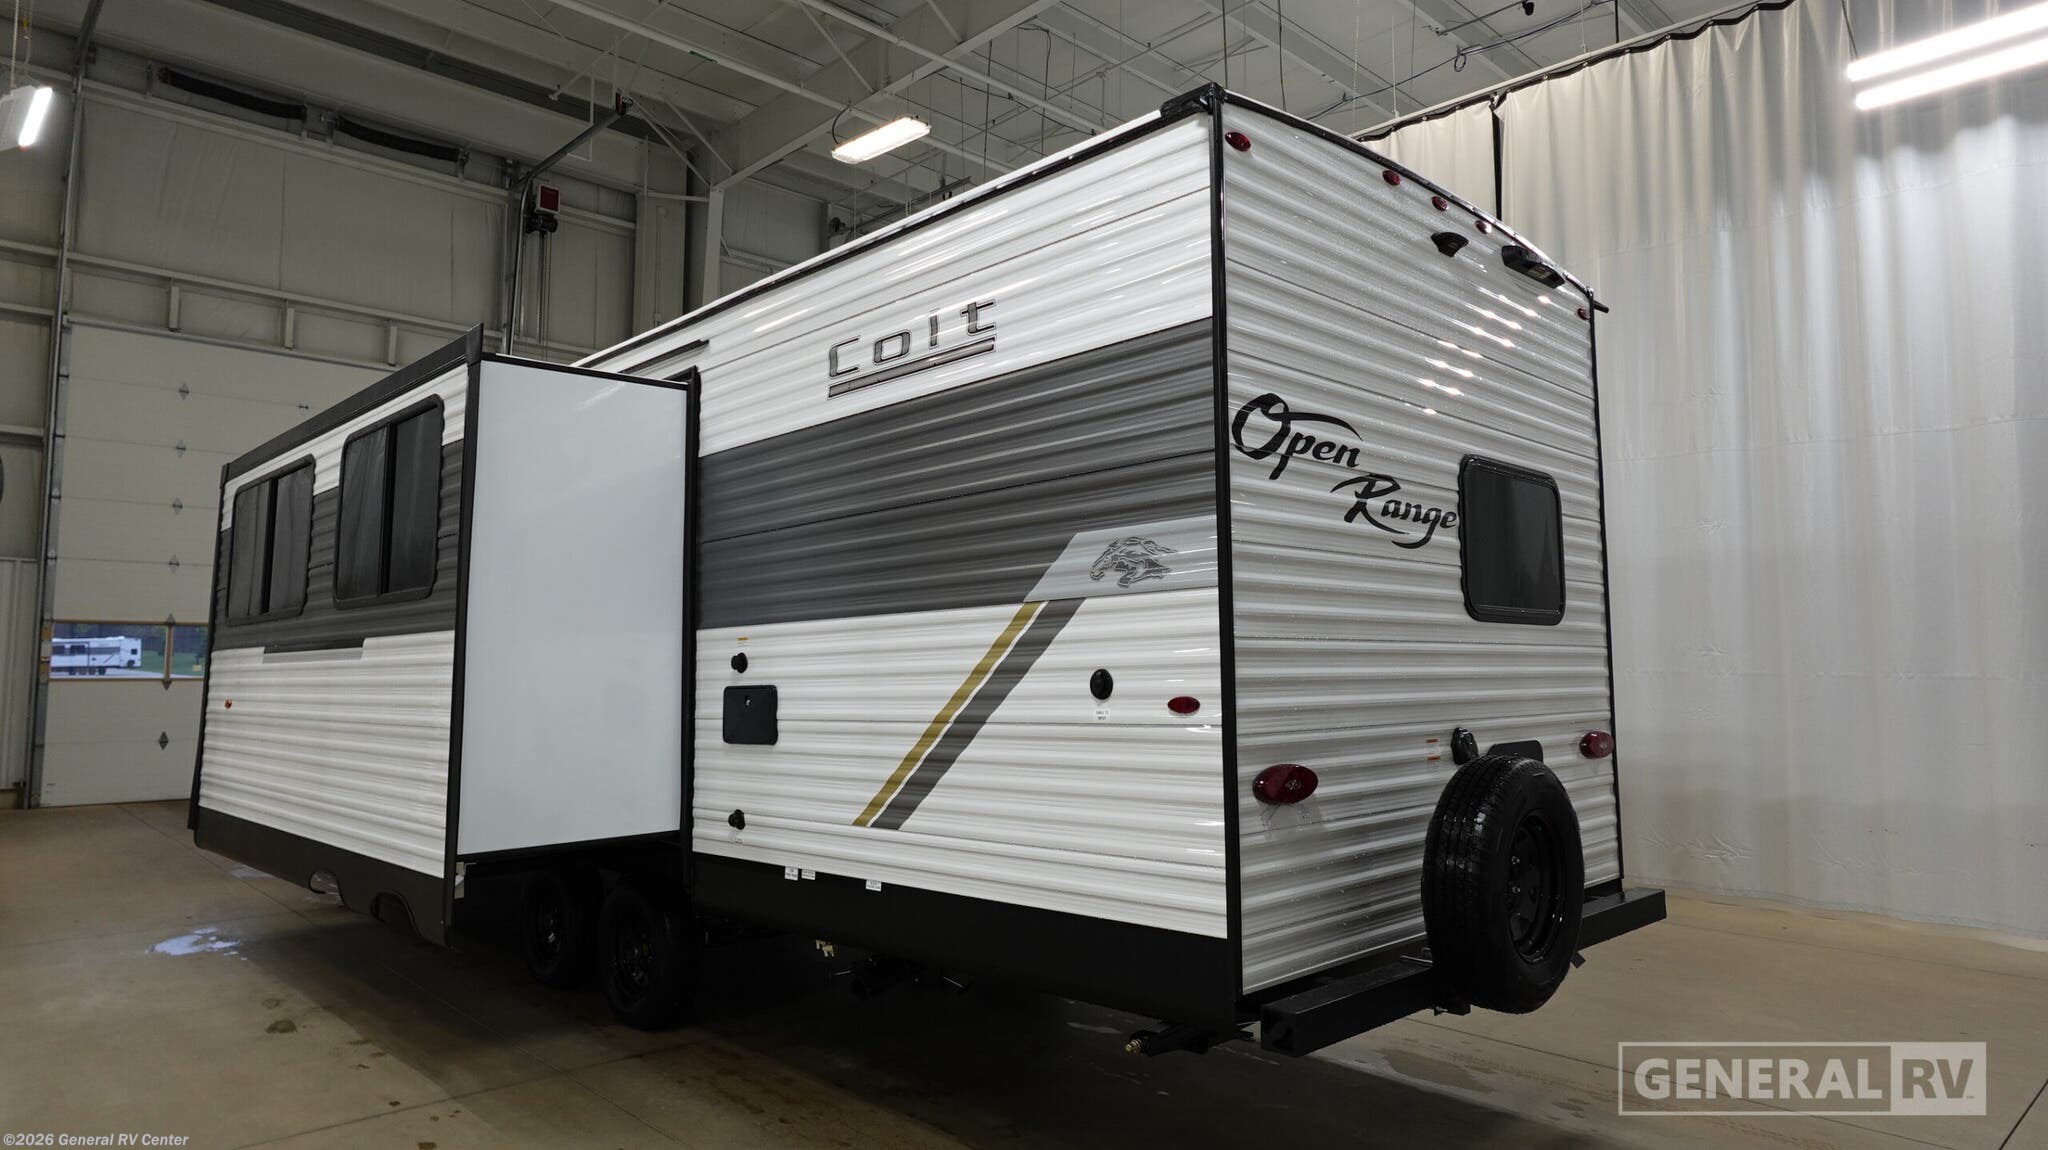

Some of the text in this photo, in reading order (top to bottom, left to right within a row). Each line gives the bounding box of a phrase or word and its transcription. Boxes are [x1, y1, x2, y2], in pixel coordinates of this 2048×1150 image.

[828, 299, 997, 379] Colt
[1231, 393, 1363, 481] Open
[1330, 473, 1457, 549] Range
